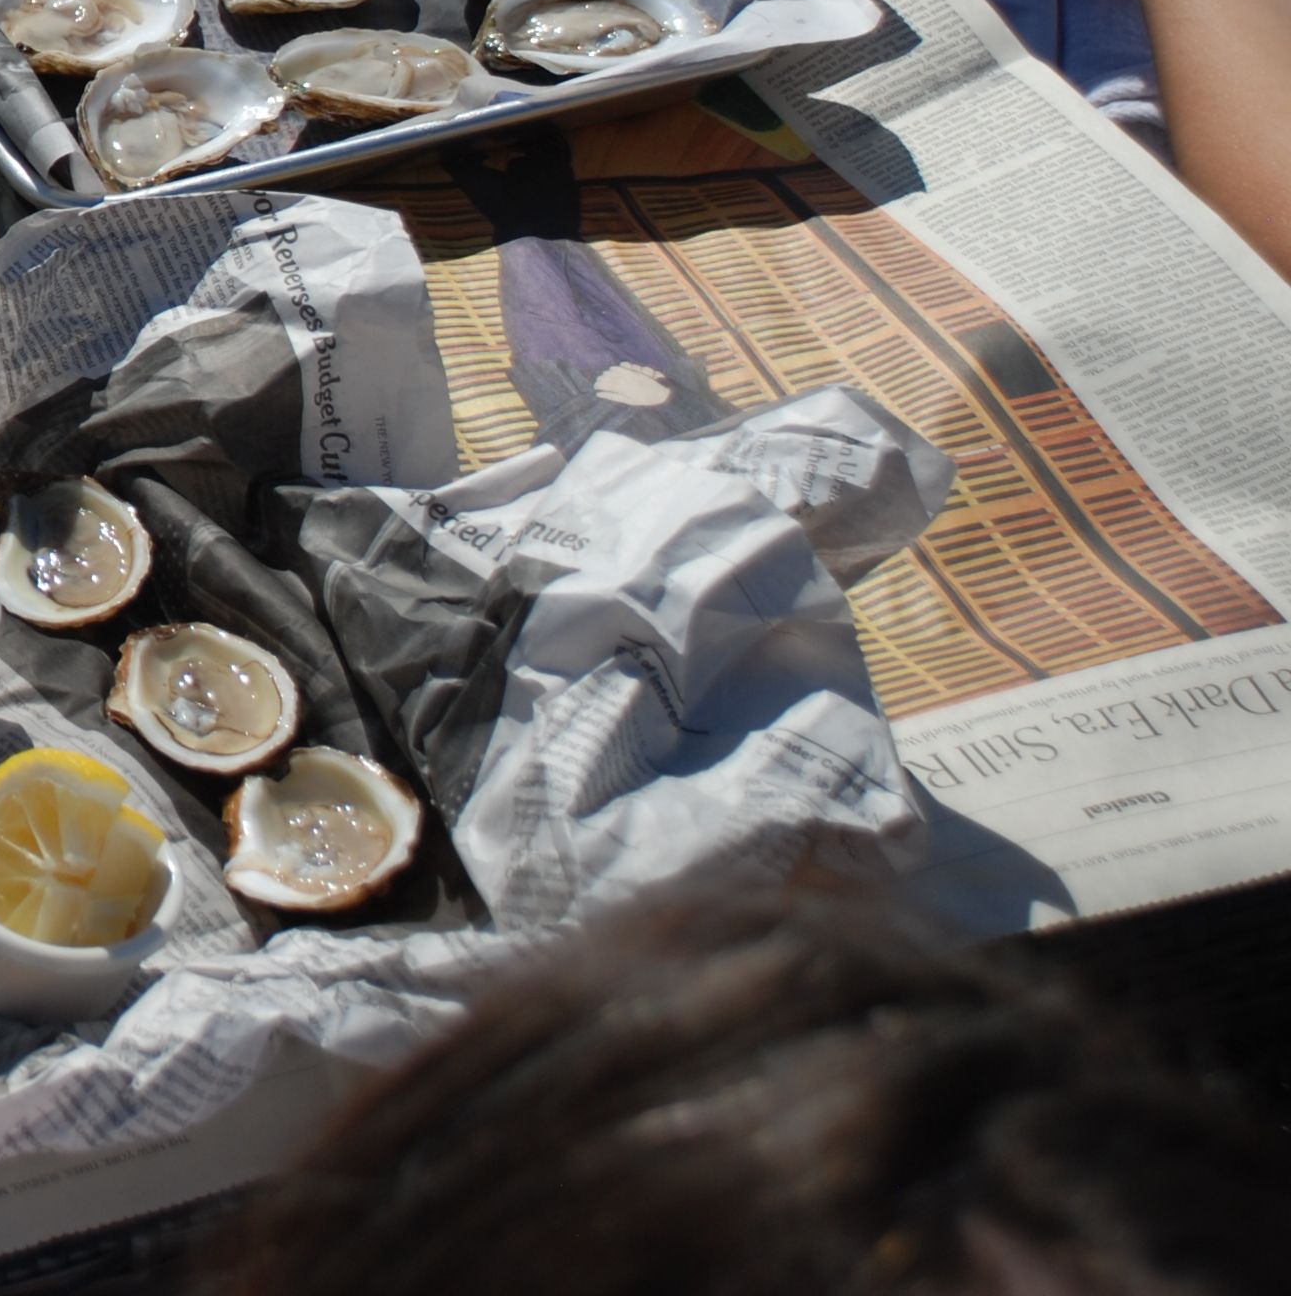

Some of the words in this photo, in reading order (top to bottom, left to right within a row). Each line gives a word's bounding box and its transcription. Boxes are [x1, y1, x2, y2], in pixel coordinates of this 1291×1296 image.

[166, 235, 182, 259] York
[264, 222, 325, 331] Reverses
[305, 333, 349, 429] Budget
[1152, 661, 1202, 677] surveys
[1152, 672, 1278, 729] Dark
[920, 722, 963, 742] World
[961, 704, 1027, 731] witnessed
[1050, 696, 1161, 752] Era,
[959, 725, 1058, 777] Still
[1080, 790, 1171, 819] Classical
